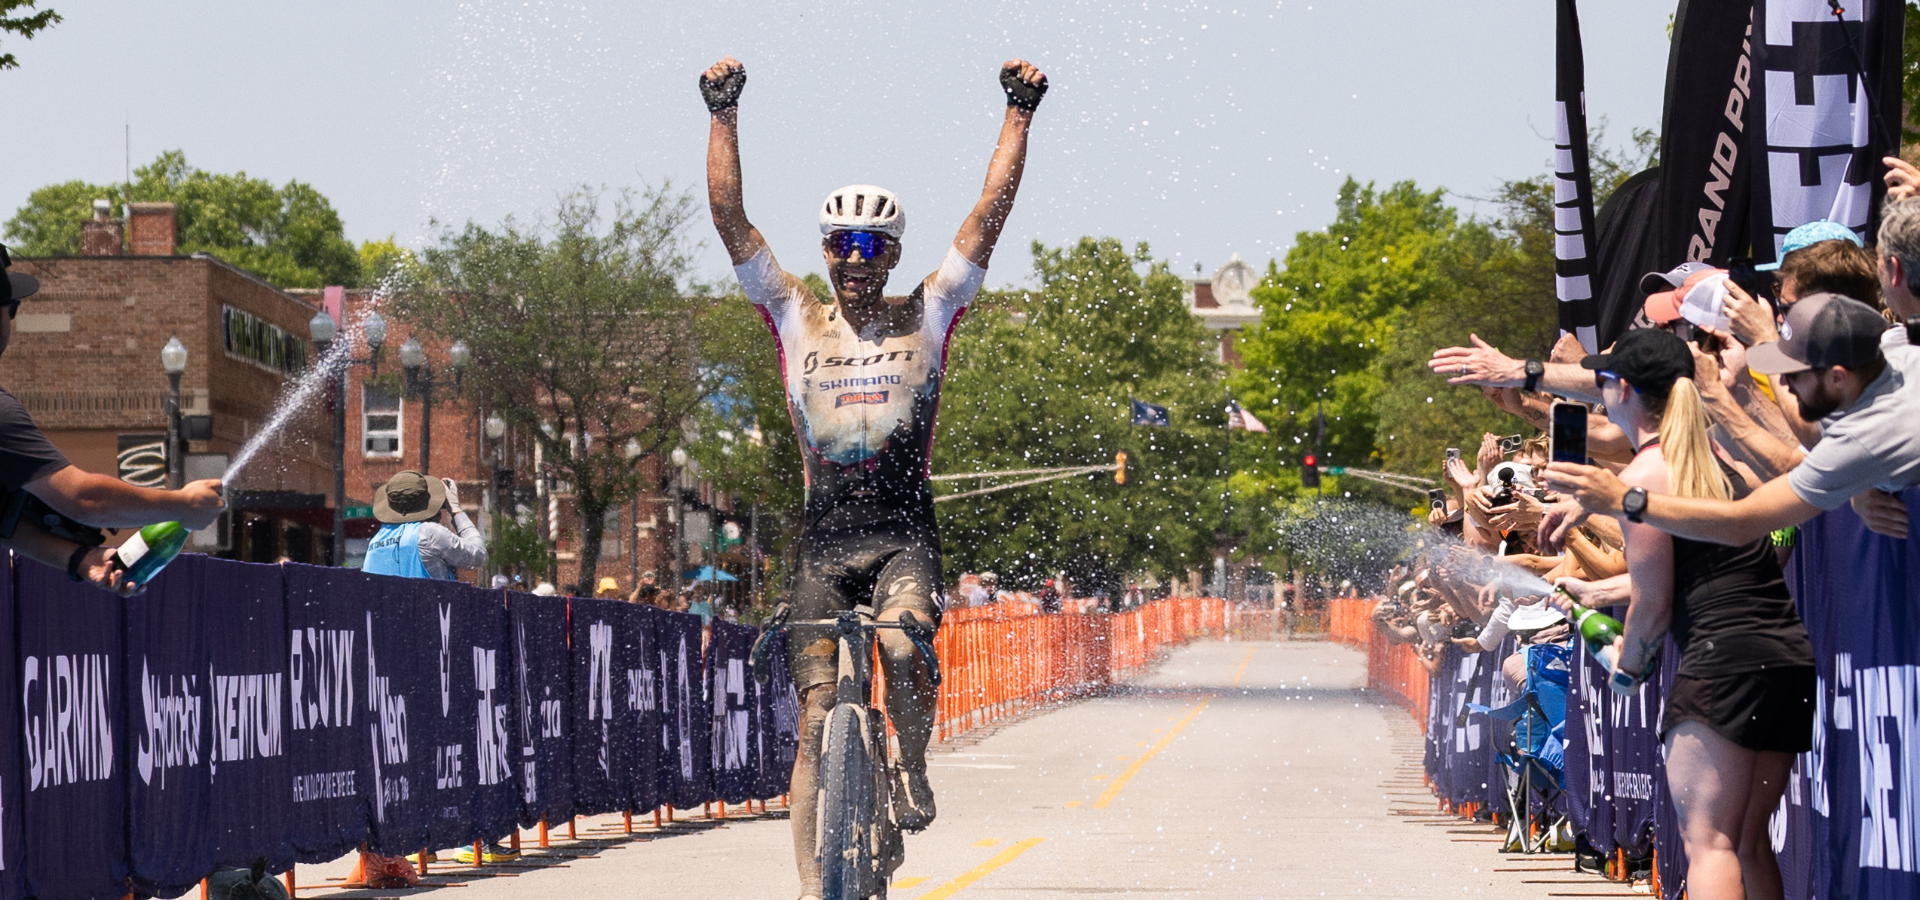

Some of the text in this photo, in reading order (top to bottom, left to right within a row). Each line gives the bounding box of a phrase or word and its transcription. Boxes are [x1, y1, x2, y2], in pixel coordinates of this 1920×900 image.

[1687, 6, 1754, 263] RAND PRI
[819, 374, 901, 392] SHIMANO
[821, 350, 917, 368] SCOTT
[24, 654, 115, 792] GARMIN
[216, 671, 283, 763] VENTUM
